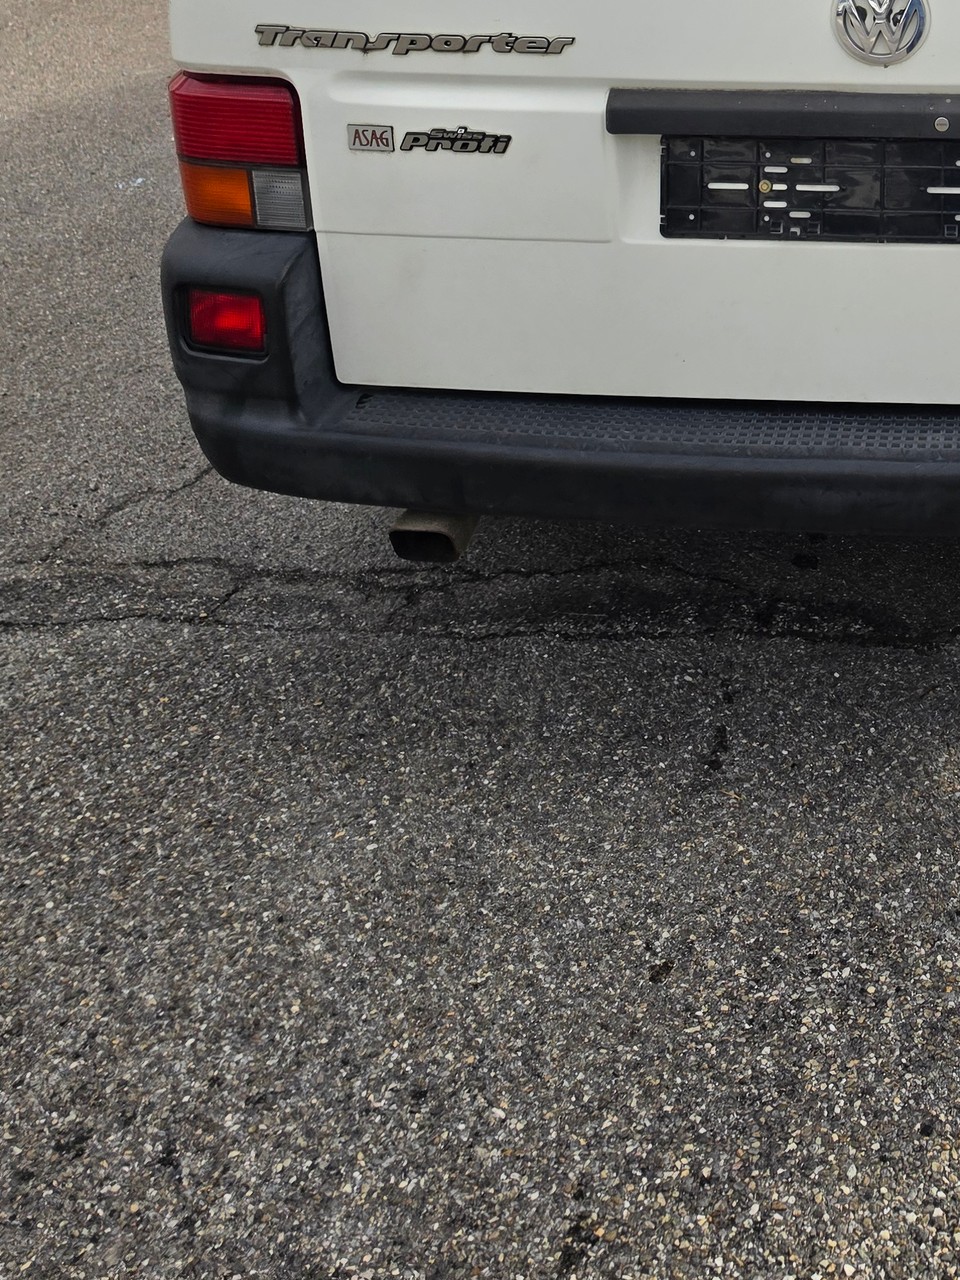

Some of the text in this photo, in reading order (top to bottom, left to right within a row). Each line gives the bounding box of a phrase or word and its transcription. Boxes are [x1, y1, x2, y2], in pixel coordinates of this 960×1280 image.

[254, 24, 576, 56] Transporter
[352, 128, 390, 148] ASAG
[401, 131, 512, 154] Profi
[430, 126, 486, 140] Swiss
